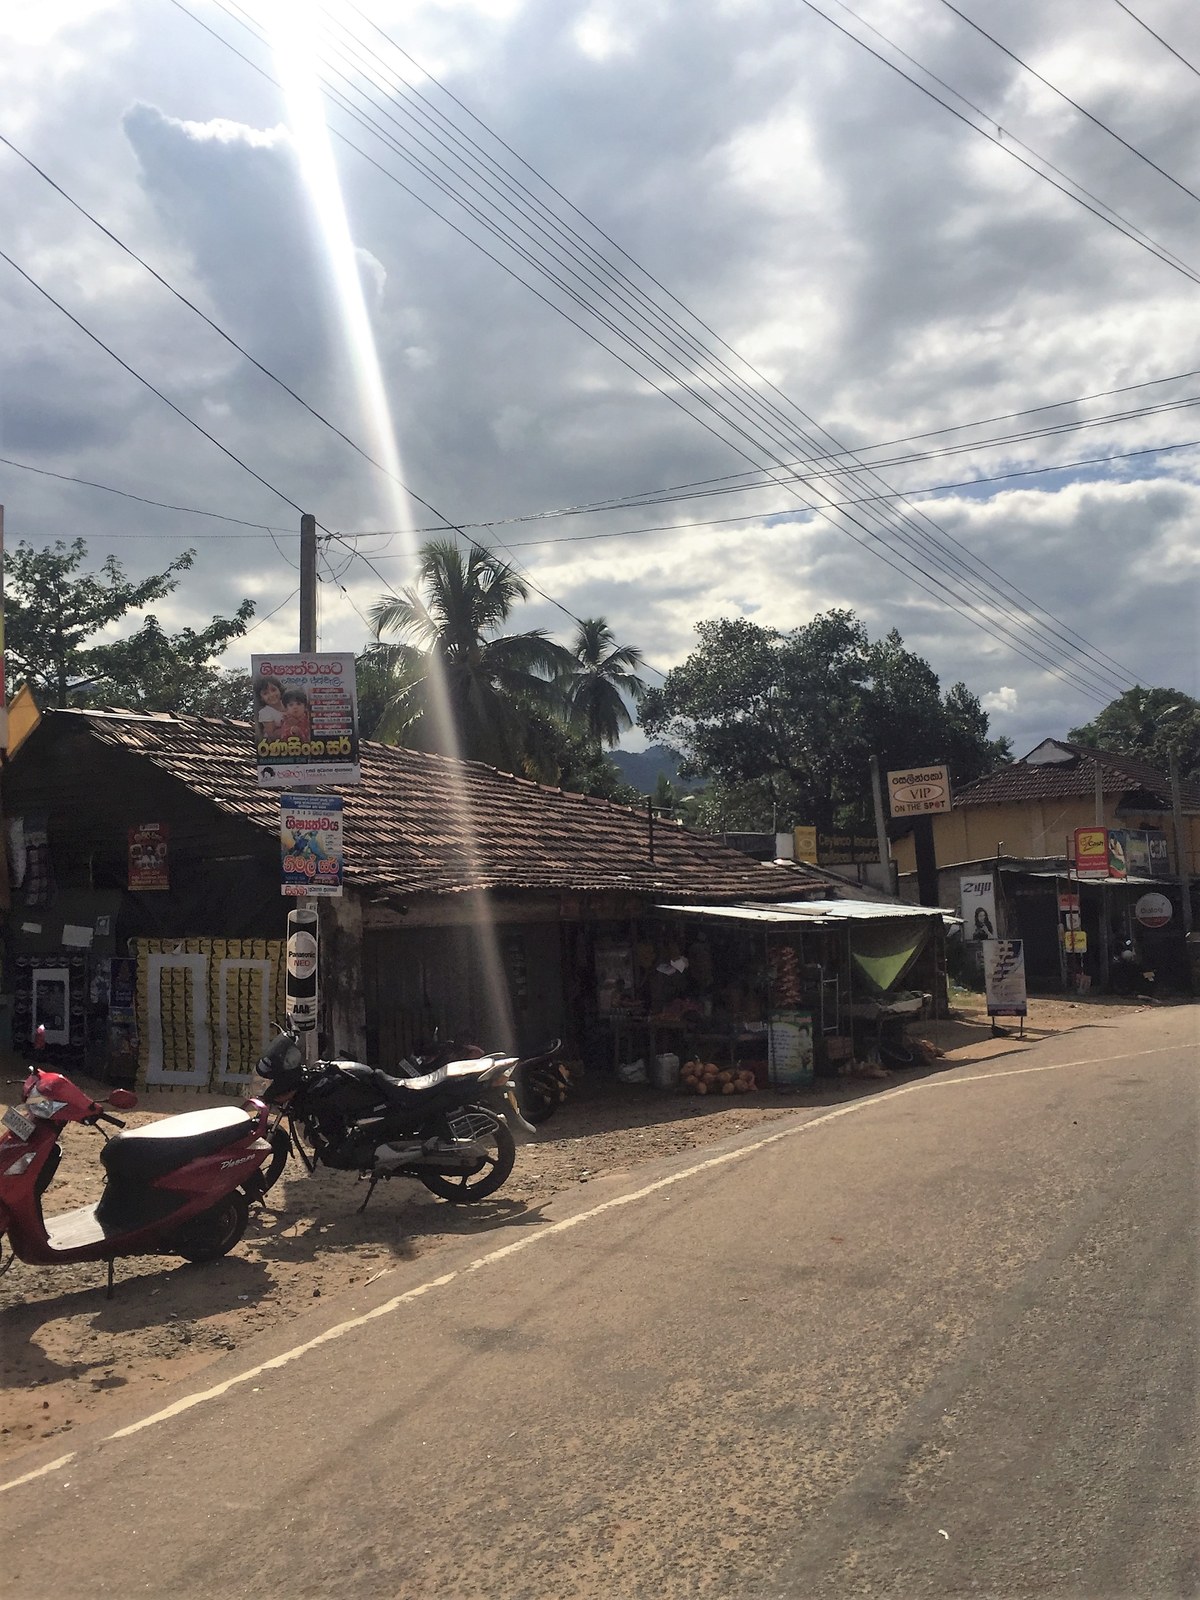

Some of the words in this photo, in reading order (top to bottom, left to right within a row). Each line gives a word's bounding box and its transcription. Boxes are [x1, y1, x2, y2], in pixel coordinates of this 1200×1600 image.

[325, 735, 352, 756] සර්
[909, 787, 931, 799] VIP
[894, 804, 905, 813] ON
[907, 803, 922, 811] THE
[924, 800, 946, 810] SPOT
[288, 951, 316, 959] Panasonic
[293, 959, 311, 967] NEO
[293, 1004, 311, 1014] AAA
